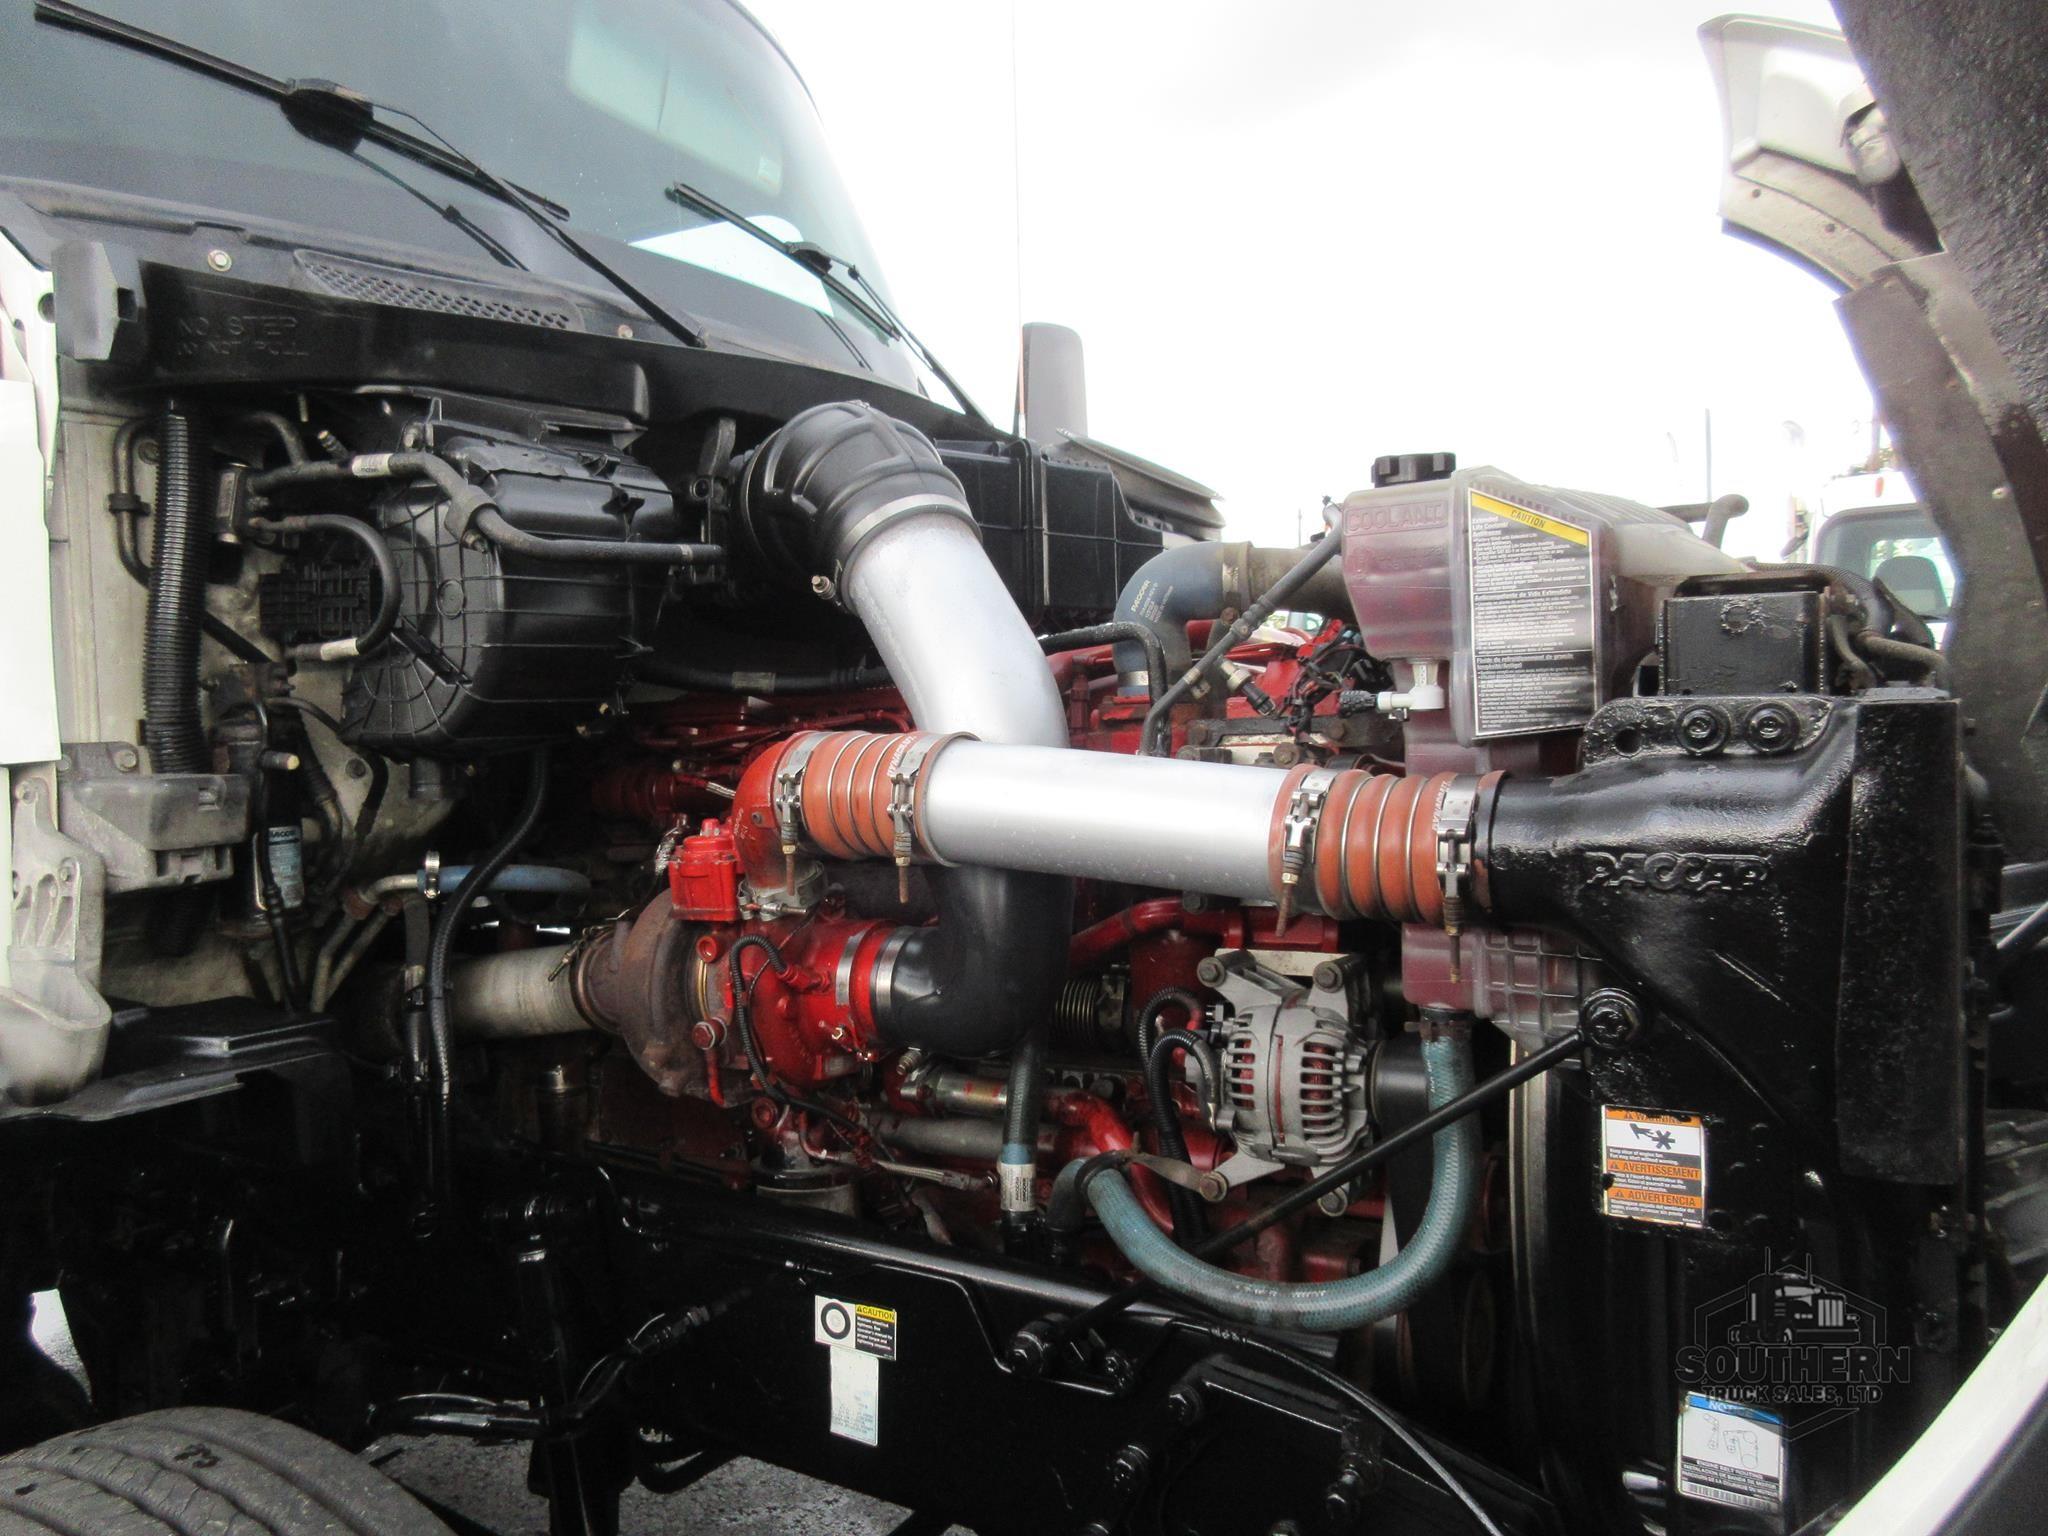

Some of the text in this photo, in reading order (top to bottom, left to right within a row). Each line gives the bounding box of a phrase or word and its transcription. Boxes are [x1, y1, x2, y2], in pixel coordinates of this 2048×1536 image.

[227, 316, 298, 335] STEP
[1349, 504, 1443, 532] COOLANT
[1511, 509, 1546, 528] CAUTION
[1583, 851, 1770, 891] PACCAR
[1622, 1162, 1699, 1178] AVERTISSEMENT
[1628, 1190, 1696, 1206] ADVERTENCIA
[862, 1306, 895, 1321] CAUTION
